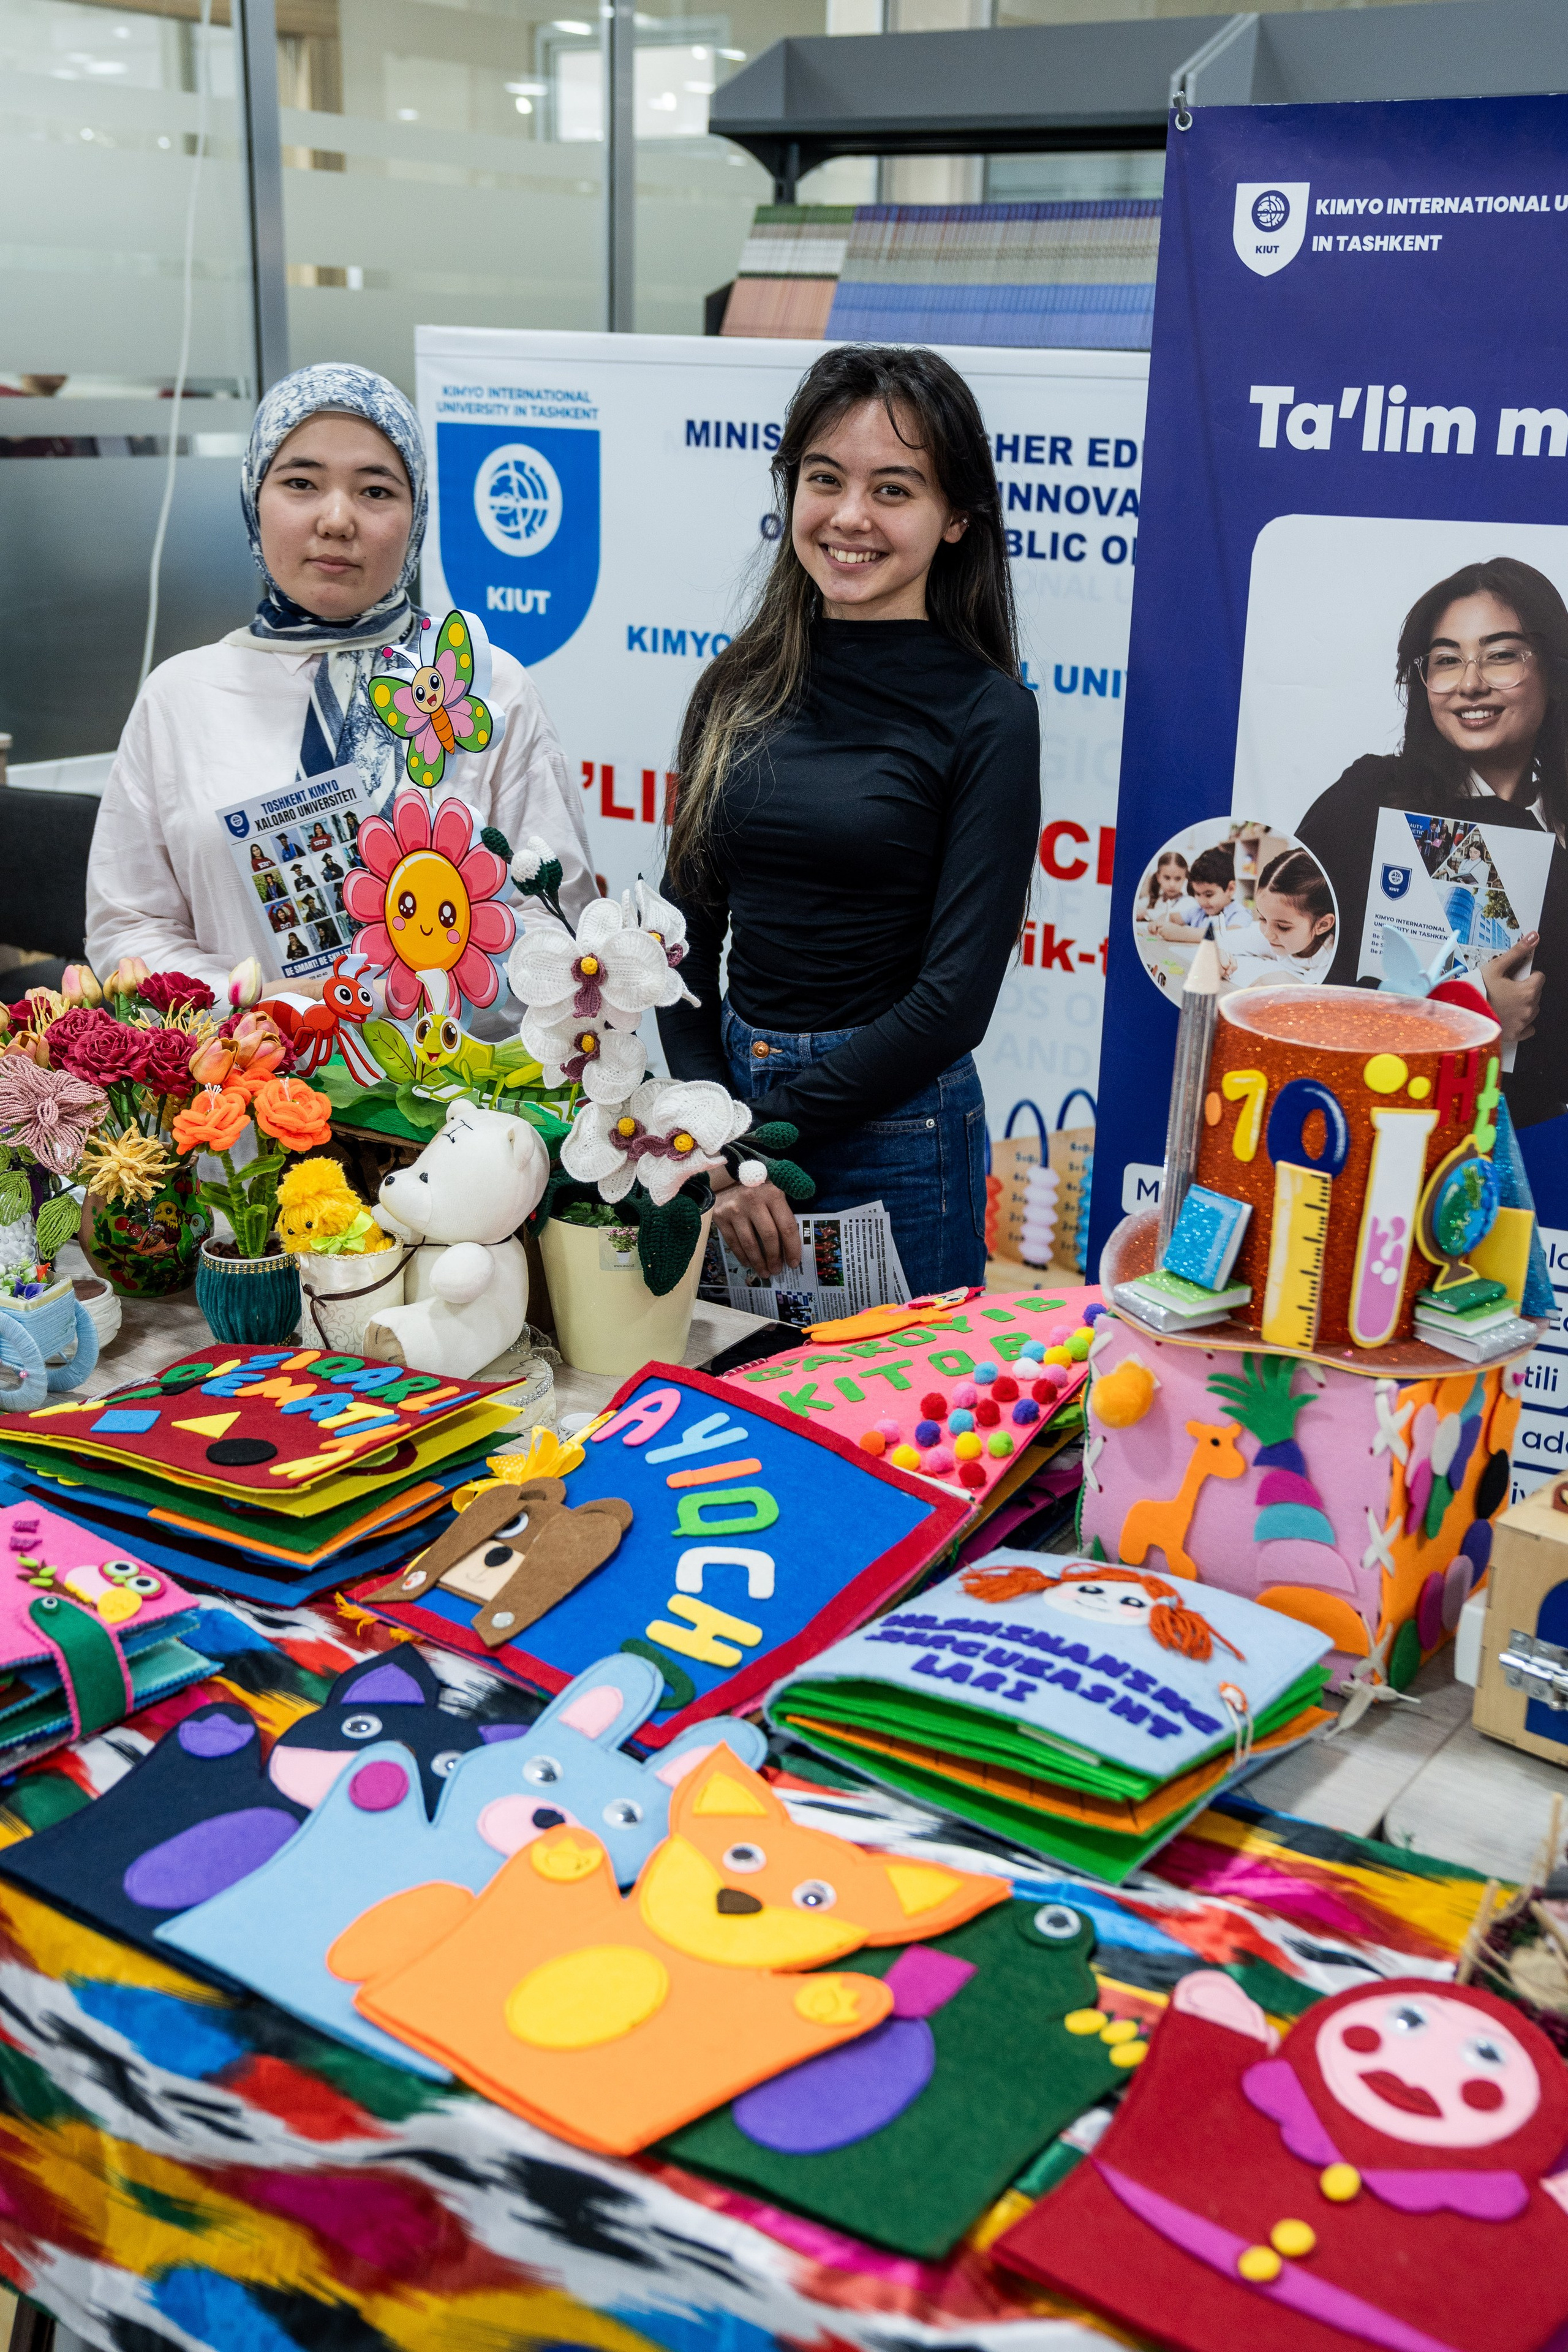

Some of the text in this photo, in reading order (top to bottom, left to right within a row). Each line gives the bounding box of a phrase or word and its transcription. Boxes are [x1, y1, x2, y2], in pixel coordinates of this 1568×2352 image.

[1316, 198, 1383, 215] KIMYO
[1387, 195, 1550, 214] INTERNATIONAL
[1254, 245, 1280, 254] KIUT
[1312, 235, 1442, 252] IN TASHKENT
[442, 384, 592, 404] KIMYO INTERNATIONAL
[436, 401, 600, 421] UNIVERSITY IN TASHKENT
[1250, 384, 1568, 457] Ta'lim m
[685, 419, 1144, 469] MINIS HER ED
[486, 586, 551, 615] KIUT
[627, 624, 732, 659] KIMYO
[1054, 663, 1128, 699] UNI
[254, 788, 358, 832] XALQARO UNIVERSITETI
[261, 779, 339, 815] TOSHKENT KIMYO
[1374, 913, 1446, 932] KIMYO INTERNATIONAL
[285, 967, 295, 977] BE
[295, 959, 320, 974] SMART!
[318, 956, 328, 966] BE
[1137, 1178, 1160, 1204] M
[159, 1349, 481, 1415] QIZIQARLI
[778, 1331, 1034, 1418] KITOB
[910, 1653, 1038, 1703] LARI
